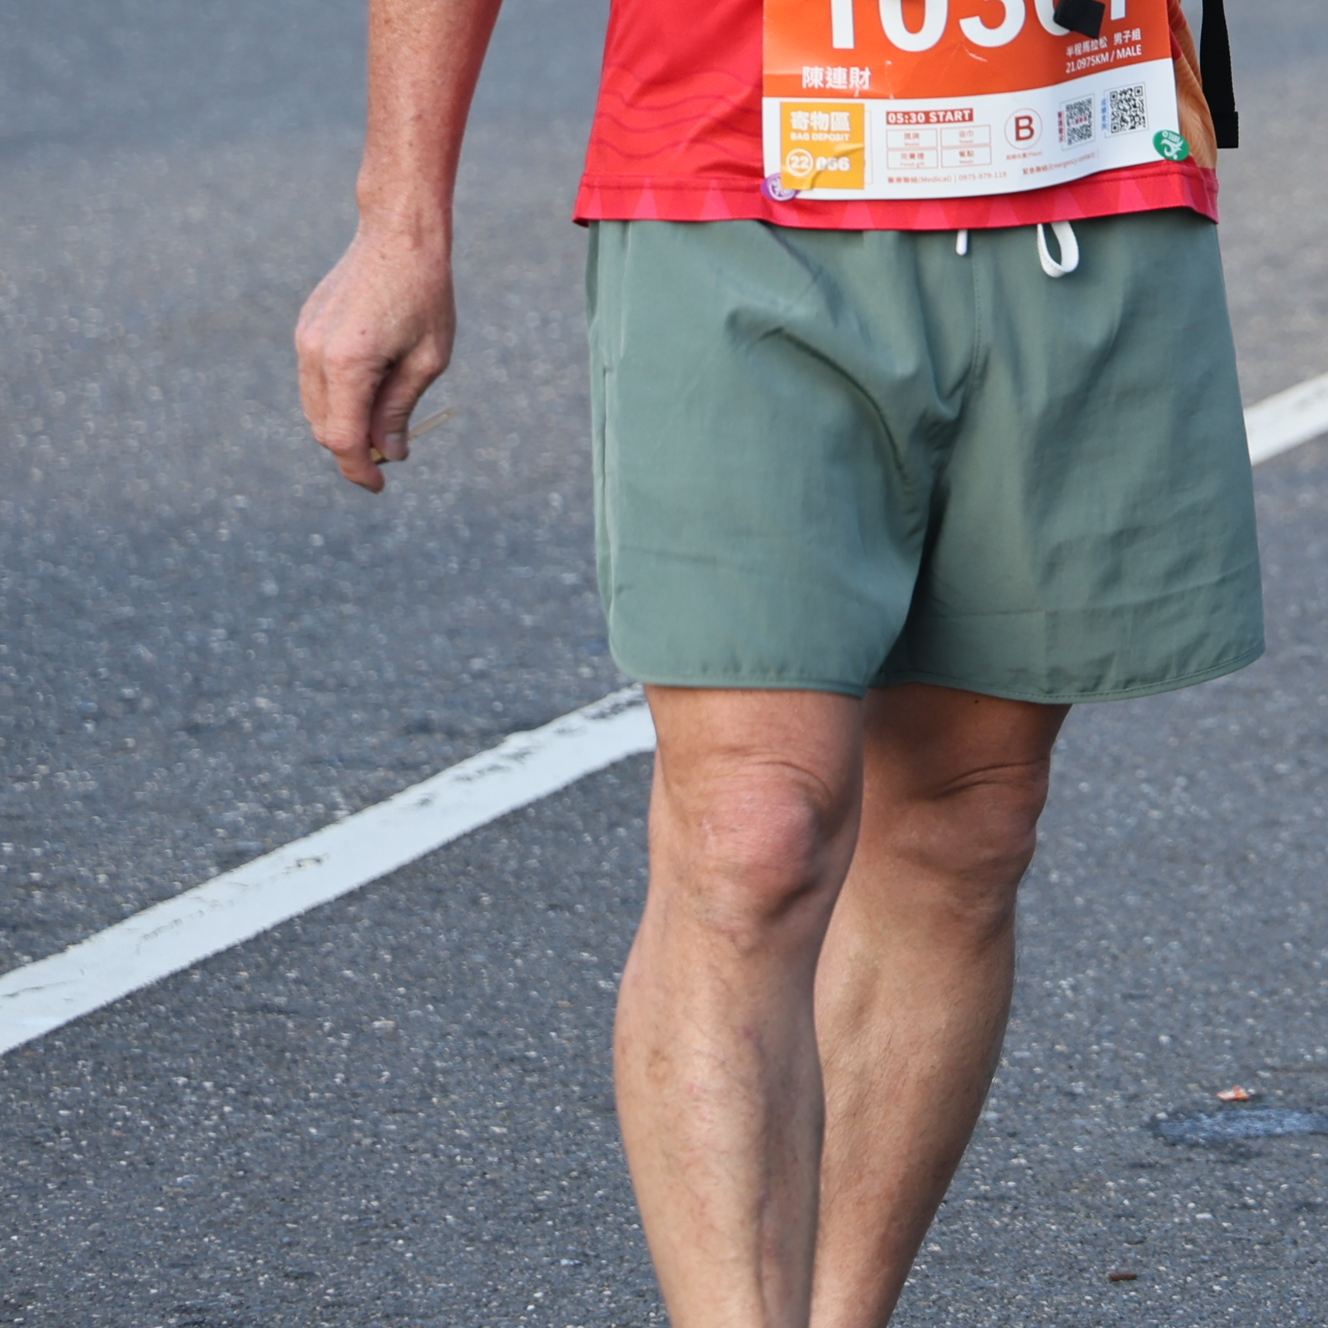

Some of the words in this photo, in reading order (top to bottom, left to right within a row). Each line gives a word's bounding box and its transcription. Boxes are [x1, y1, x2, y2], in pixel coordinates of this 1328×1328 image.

[1113, 27, 1142, 46] 男子組
[1065, 51, 1109, 74] 21.0975KM
[1116, 44, 1142, 60] MALE
[802, 65, 872, 90] 陳連財
[790, 111, 850, 132] 寄物區
[888, 111, 926, 124] 05:30
[929, 110, 971, 123] START
[790, 132, 810, 141] BAG
[811, 132, 851, 142] DEPOSIT
[1014, 115, 1035, 142] B
[789, 155, 810, 169] 22
